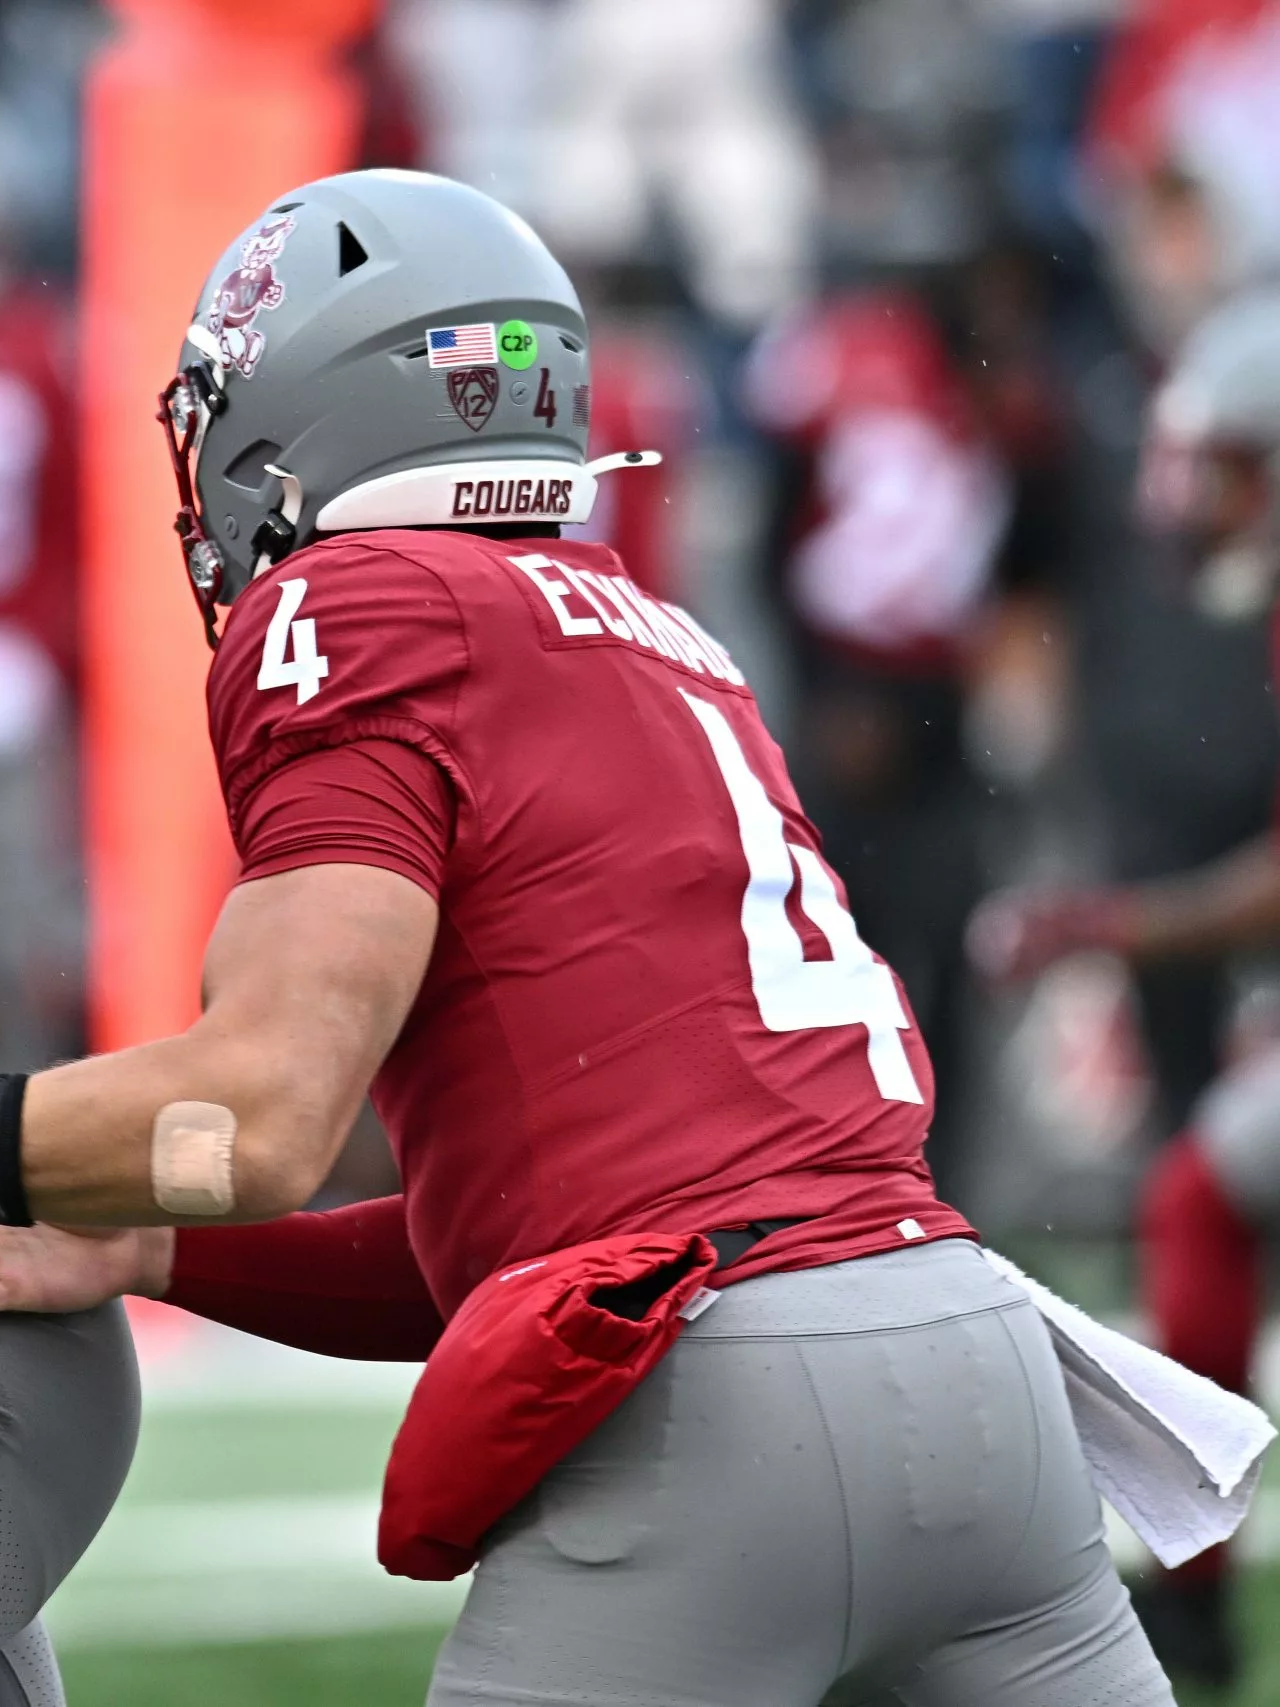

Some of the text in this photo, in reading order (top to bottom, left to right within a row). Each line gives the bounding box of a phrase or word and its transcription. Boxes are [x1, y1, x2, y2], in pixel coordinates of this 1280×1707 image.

[500, 334, 533, 353] C2P
[449, 370, 498, 403] PAC
[532, 367, 557, 429] 4
[463, 395, 488, 418] 12
[451, 479, 573, 517] COUGARS
[257, 577, 329, 706] 4
[675, 687, 925, 1105] 4
